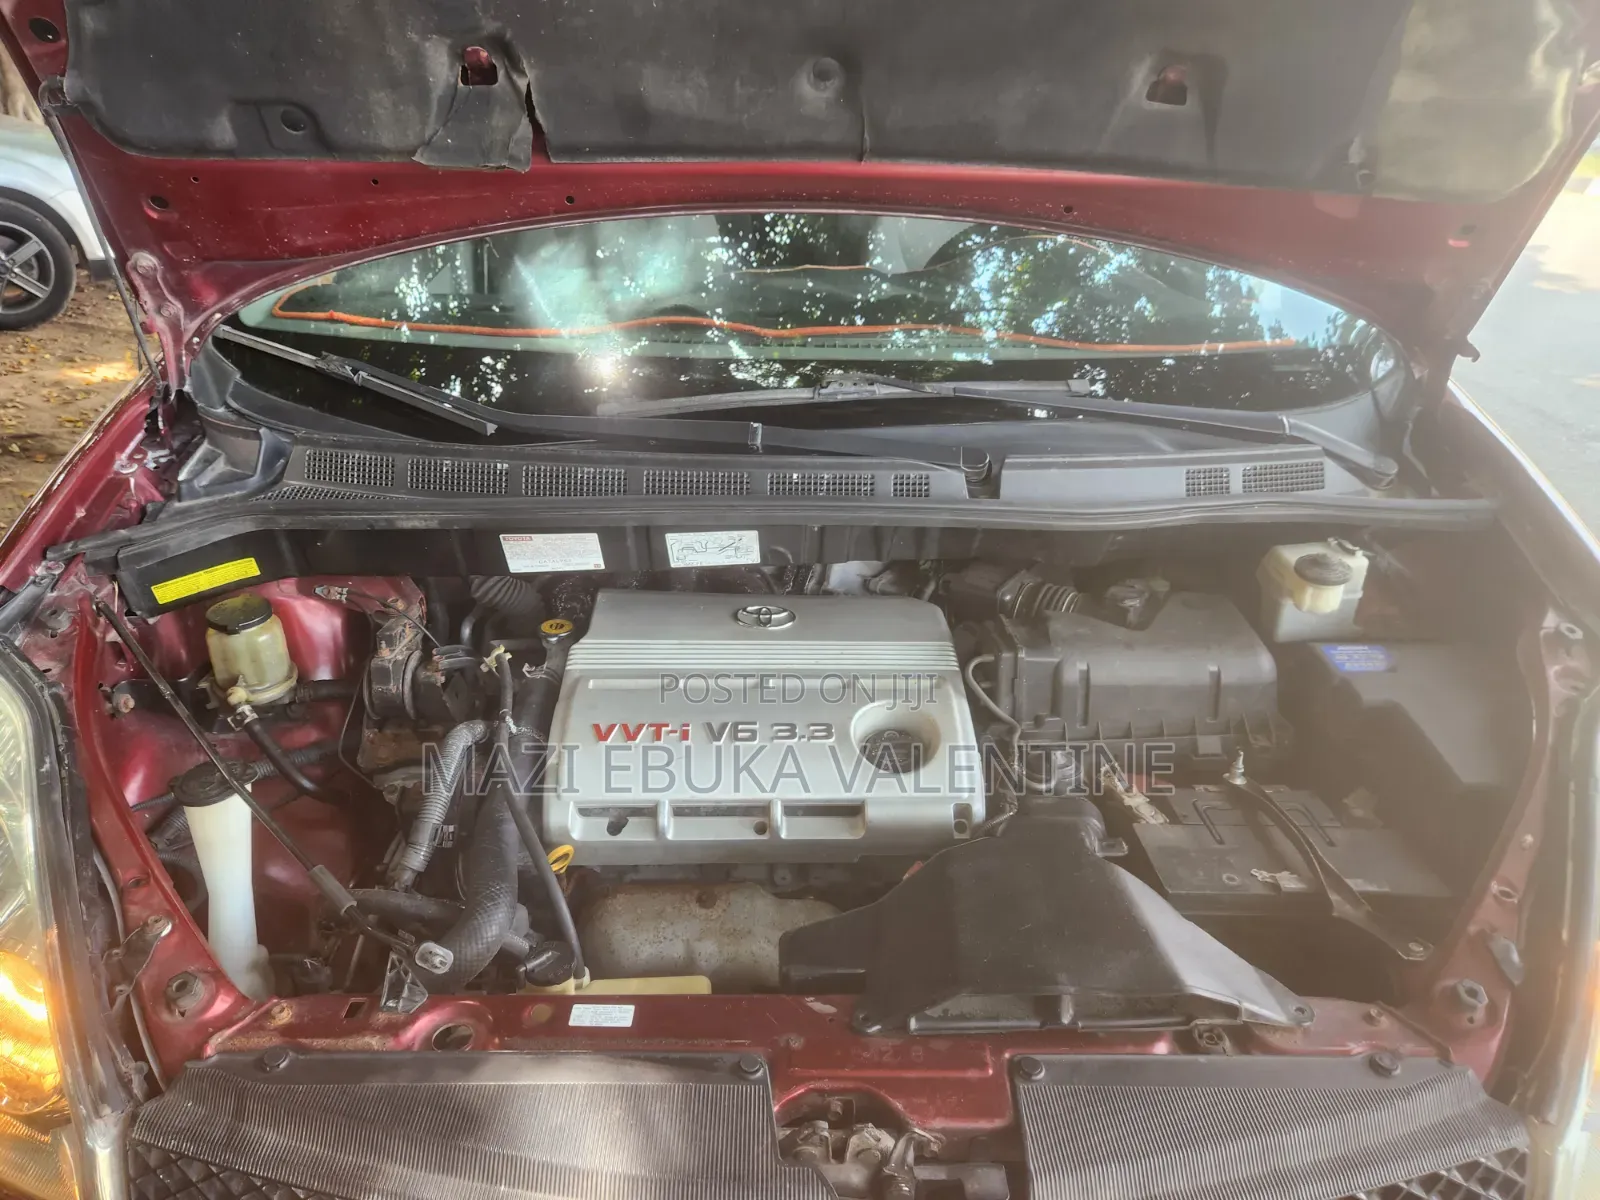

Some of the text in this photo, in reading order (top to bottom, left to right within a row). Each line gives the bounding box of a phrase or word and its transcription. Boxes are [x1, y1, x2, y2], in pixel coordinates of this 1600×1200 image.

[592, 721, 836, 744] VVT-i V6 3.3
